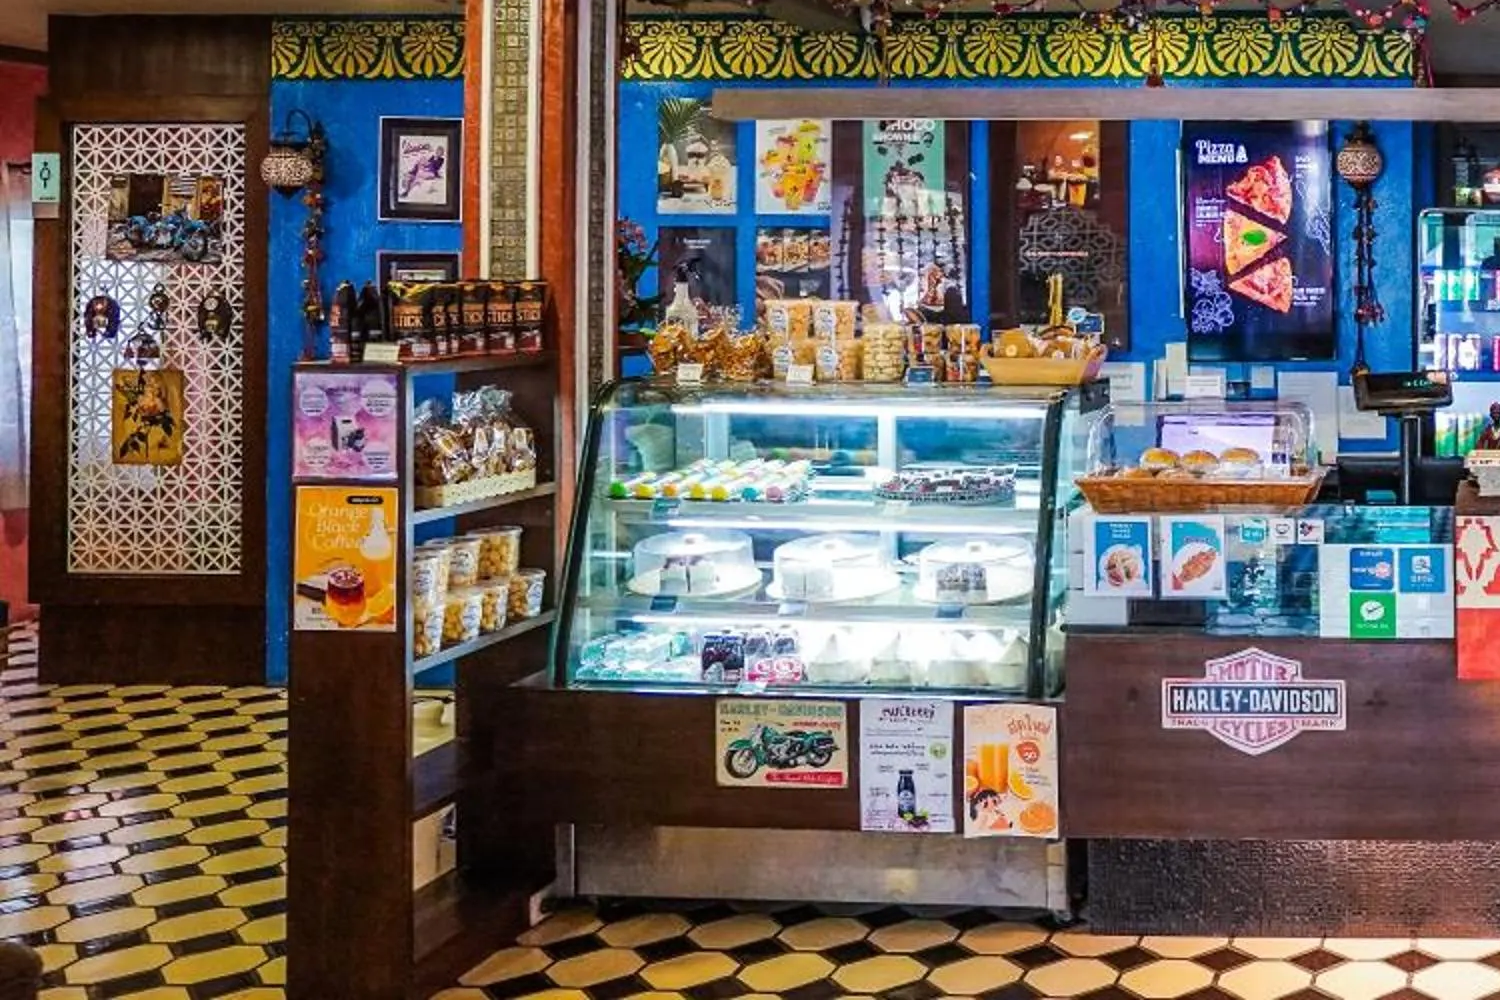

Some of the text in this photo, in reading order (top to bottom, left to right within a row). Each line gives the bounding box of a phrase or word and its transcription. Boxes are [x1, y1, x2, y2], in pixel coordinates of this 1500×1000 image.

[1196, 139, 1234, 155] Pizza
[1197, 153, 1235, 164] MENU
[1219, 658, 1288, 681] MOTOR
[1173, 688, 1336, 713] HARLEY-DAVIDSON
[1219, 718, 1289, 744] CYCLES
